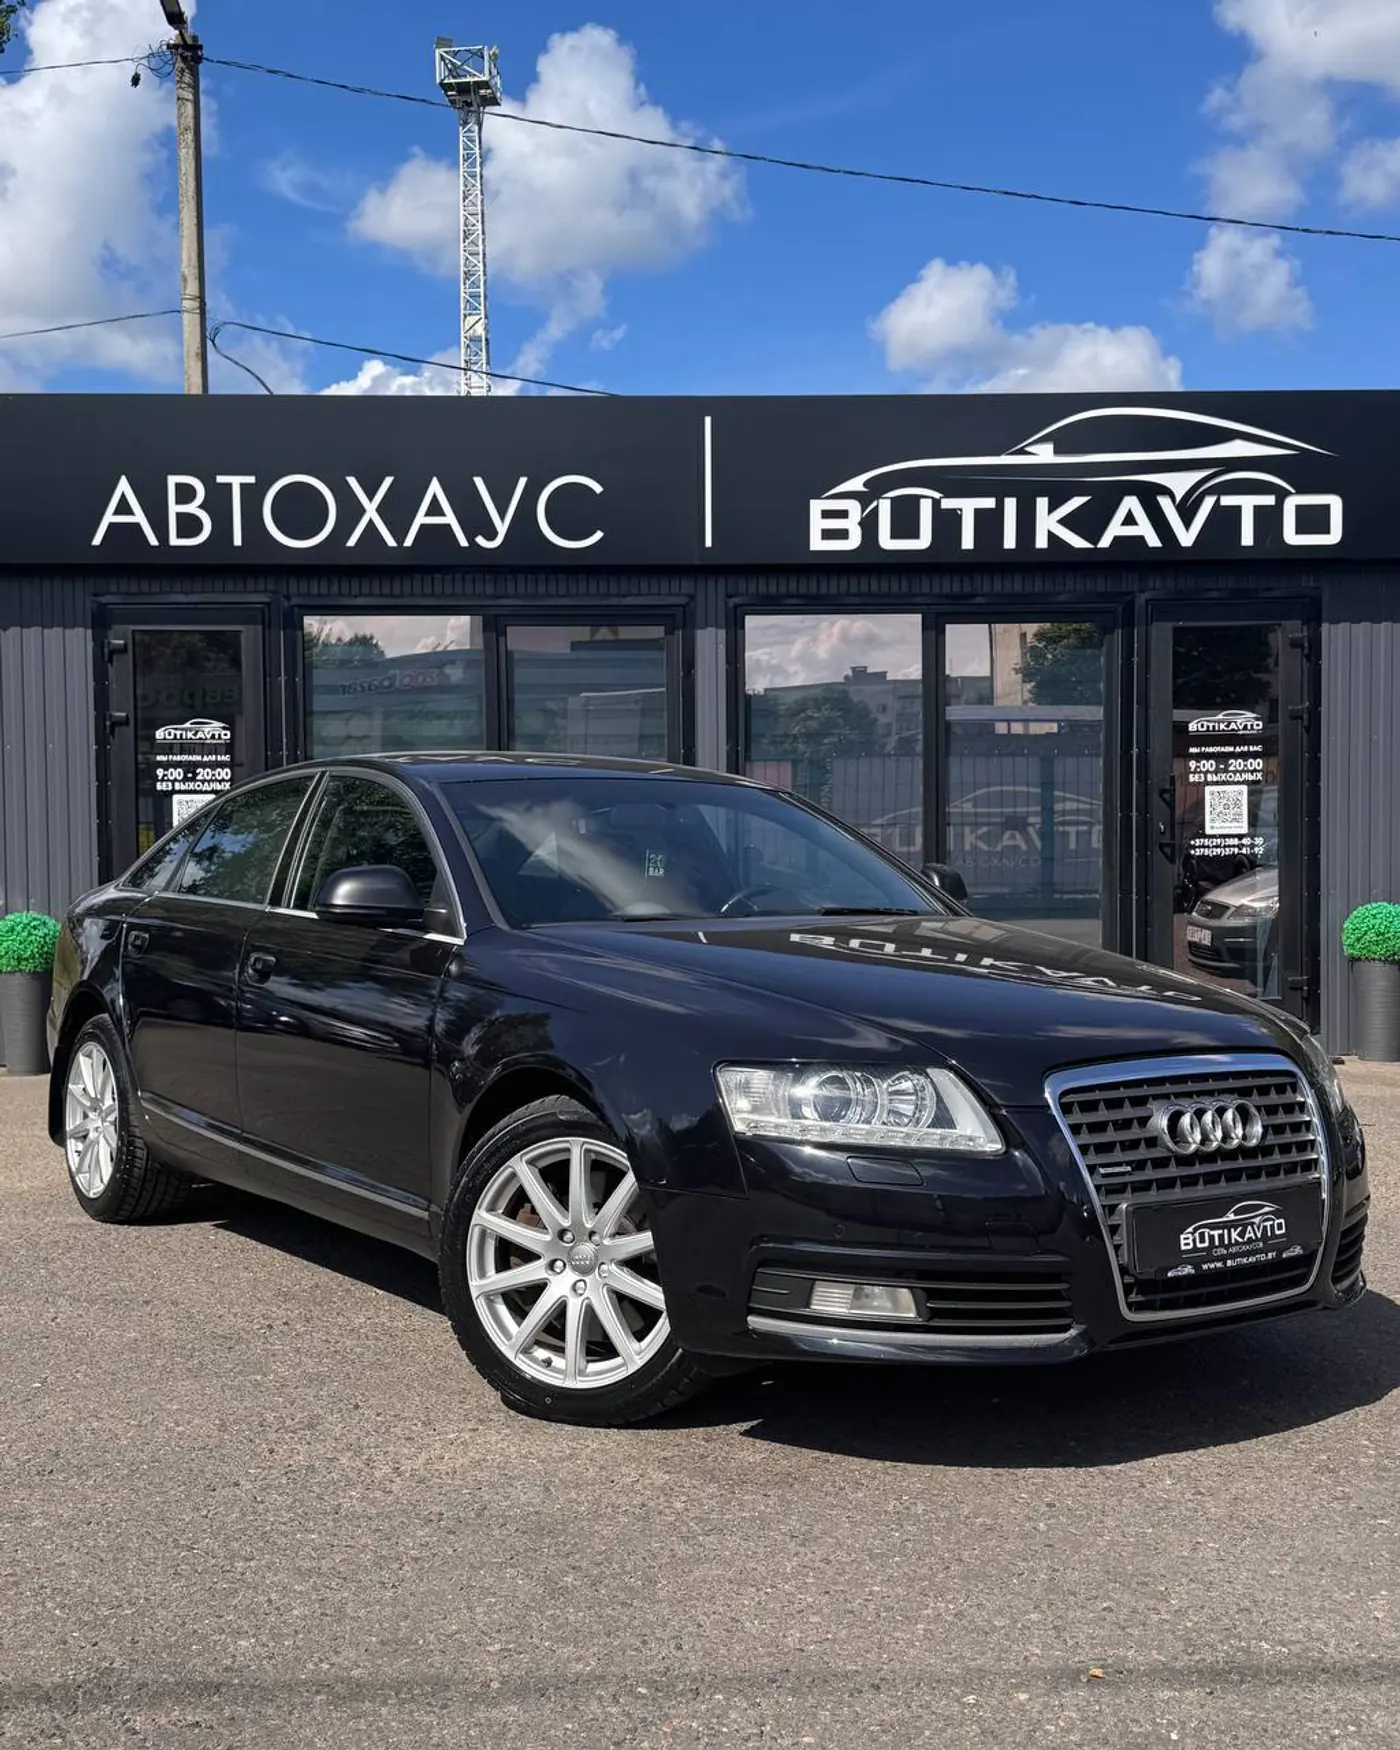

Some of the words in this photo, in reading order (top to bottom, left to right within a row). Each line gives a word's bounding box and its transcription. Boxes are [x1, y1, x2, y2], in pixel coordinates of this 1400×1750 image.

[91, 474, 604, 549] АВТОХАУС
[809, 493, 1343, 552] BUTIKAVTO
[1188, 720, 1263, 732] BUTIKAVTO
[155, 729, 230, 740] BUTIKAVTO
[1249, 744, 1263, 752] ВАС
[1189, 760, 1216, 772] 9:00
[1228, 758, 1263, 771] 20:00
[156, 768, 184, 780] 9:00
[195, 768, 231, 780] 20:00
[1189, 773, 1205, 782] БЕЗ
[1207, 772, 1263, 782] ВЫХОДНЫХ
[156, 781, 172, 791] БЕЗ
[174, 781, 231, 791] ВЫХОДНЫХ
[1180, 1218, 1286, 1250] BUTIKAVTO
